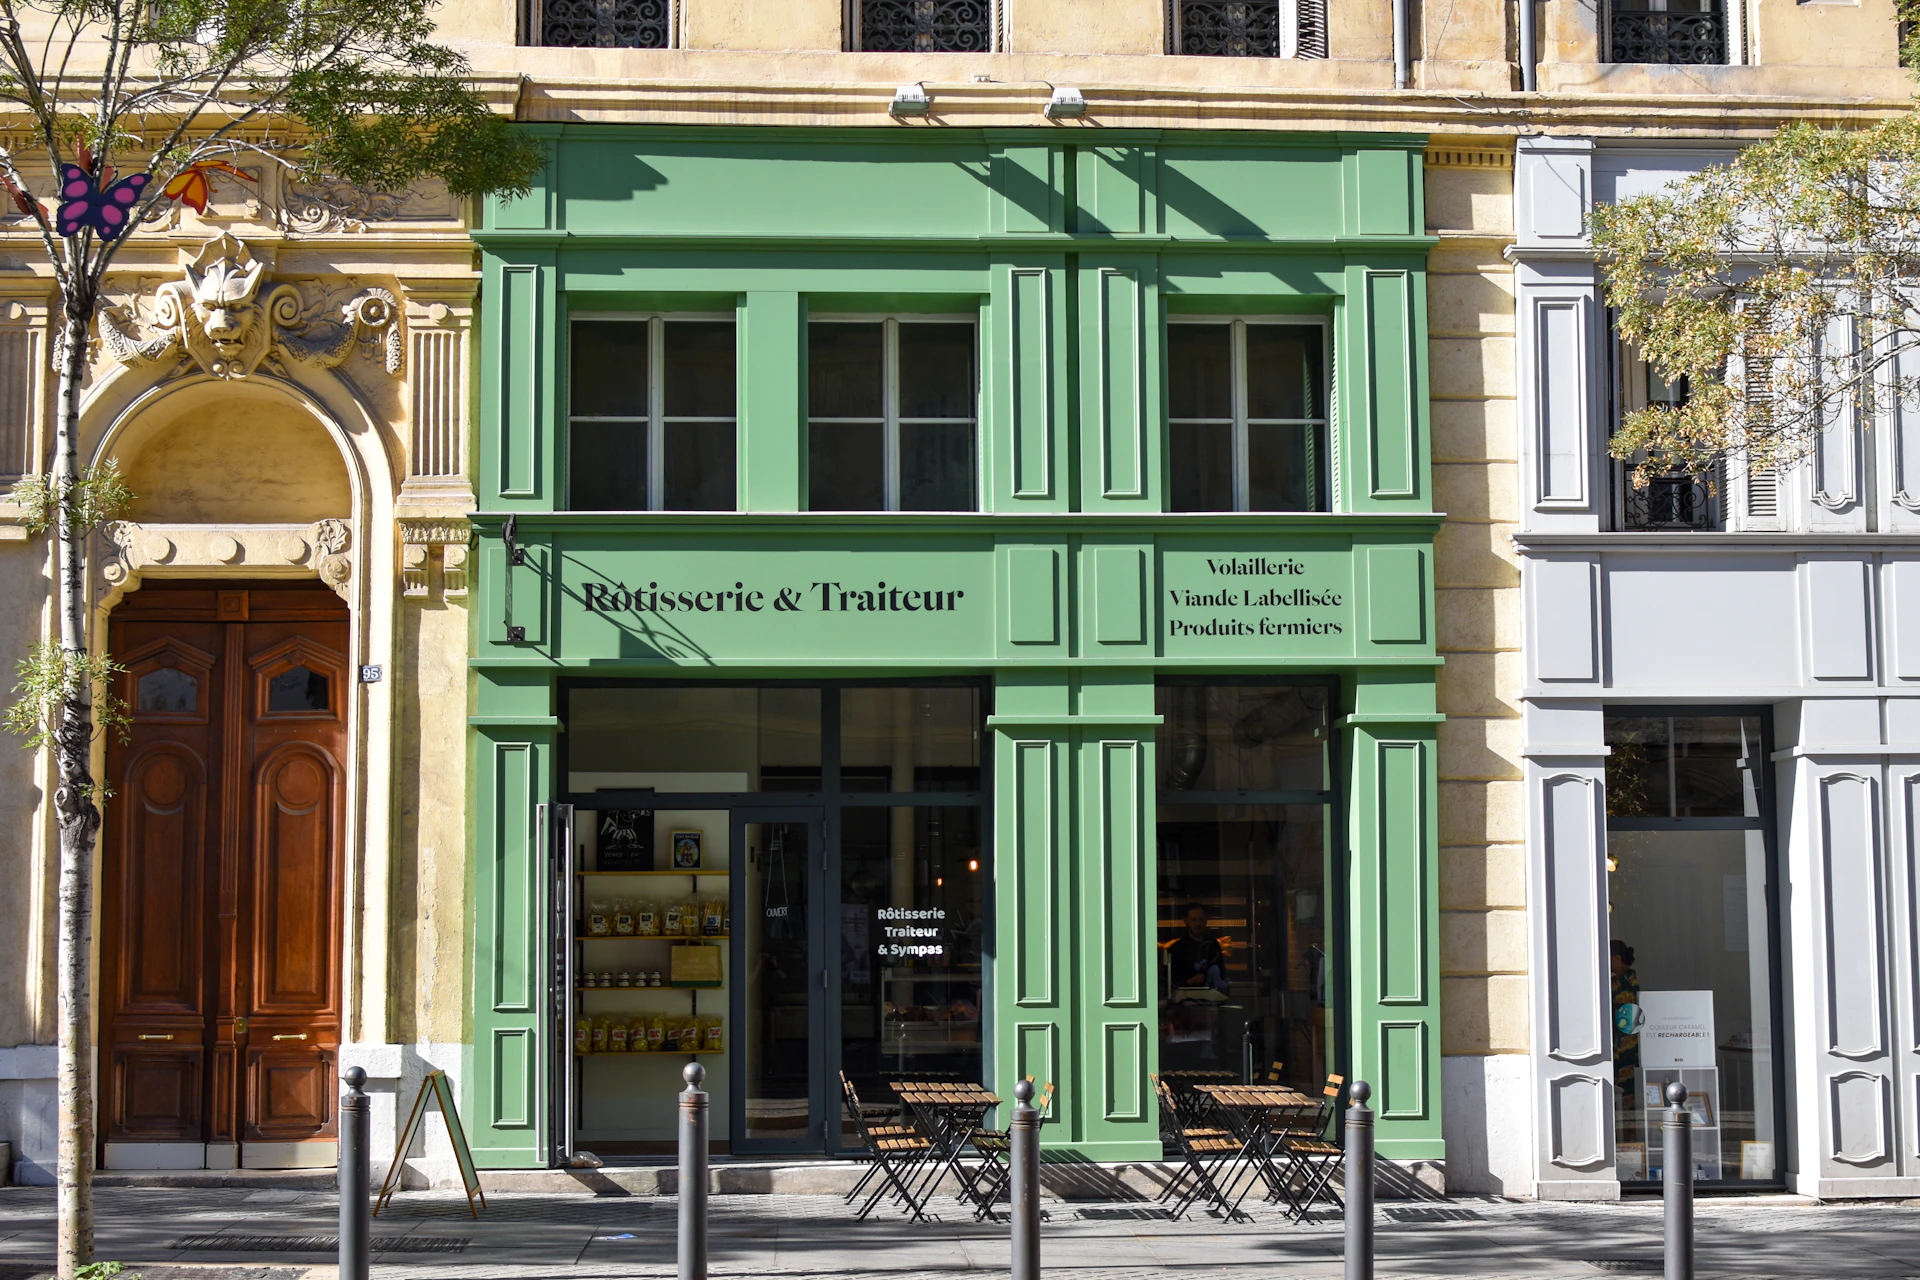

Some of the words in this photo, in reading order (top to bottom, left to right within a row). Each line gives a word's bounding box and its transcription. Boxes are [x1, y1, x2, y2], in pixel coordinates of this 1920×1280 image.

[1205, 557, 1305, 576] Volaillerie
[583, 581, 765, 612] Rôtisserie
[773, 587, 804, 612] &
[810, 581, 964, 612] Traiteur
[1169, 588, 1239, 606] Viande
[1243, 588, 1342, 606] Labellisée
[1169, 618, 1254, 636] Produits
[1259, 617, 1342, 636] fermiers
[363, 668, 379, 679] 95
[766, 906, 788, 917] OUVERT
[877, 907, 946, 920] Rôtisserie
[884, 925, 939, 937] Traiteur
[877, 944, 888, 955] &
[890, 944, 943, 957] Sympas
